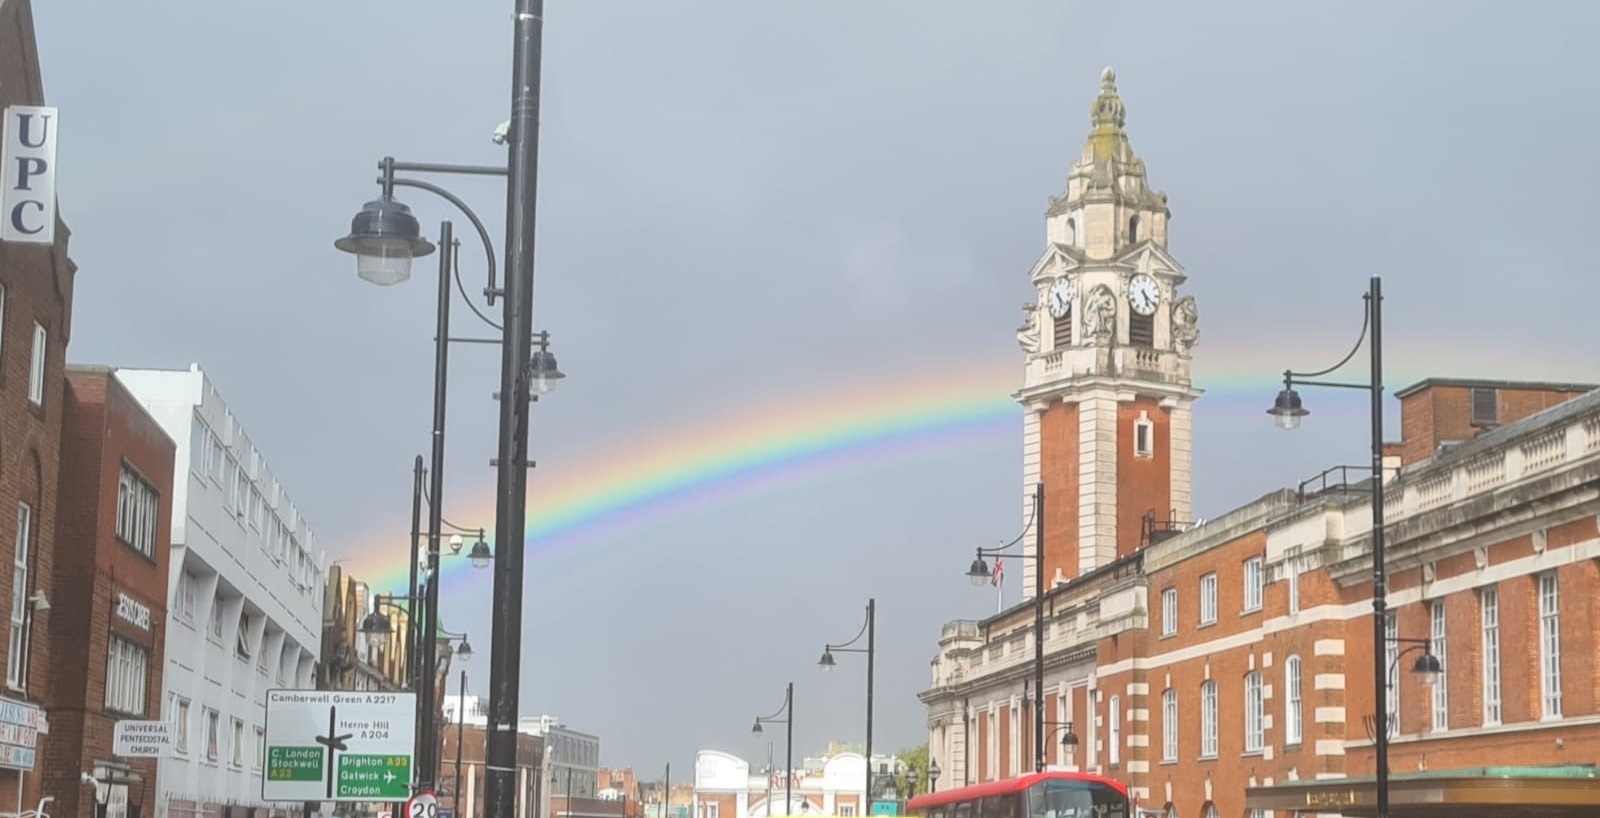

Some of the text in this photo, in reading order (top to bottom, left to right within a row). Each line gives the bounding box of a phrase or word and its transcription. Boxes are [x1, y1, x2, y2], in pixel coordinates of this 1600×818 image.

[11, 113, 51, 235] UPC
[271, 693, 396, 704] Camberwell Green A2217
[124, 723, 168, 733] UNIVERSAL
[340, 720, 389, 730] Herne Hill
[120, 734, 170, 744] PENTECOSTAL
[361, 730, 389, 739] A204
[131, 745, 160, 754] CHURCH
[272, 749, 320, 759] C. London
[271, 759, 319, 769] Stockwell
[342, 756, 407, 767] Brighton A23
[271, 768, 292, 778] A23
[341, 770, 379, 780] Gatwick
[340, 785, 381, 796] Croydon
[413, 803, 437, 818] 20
